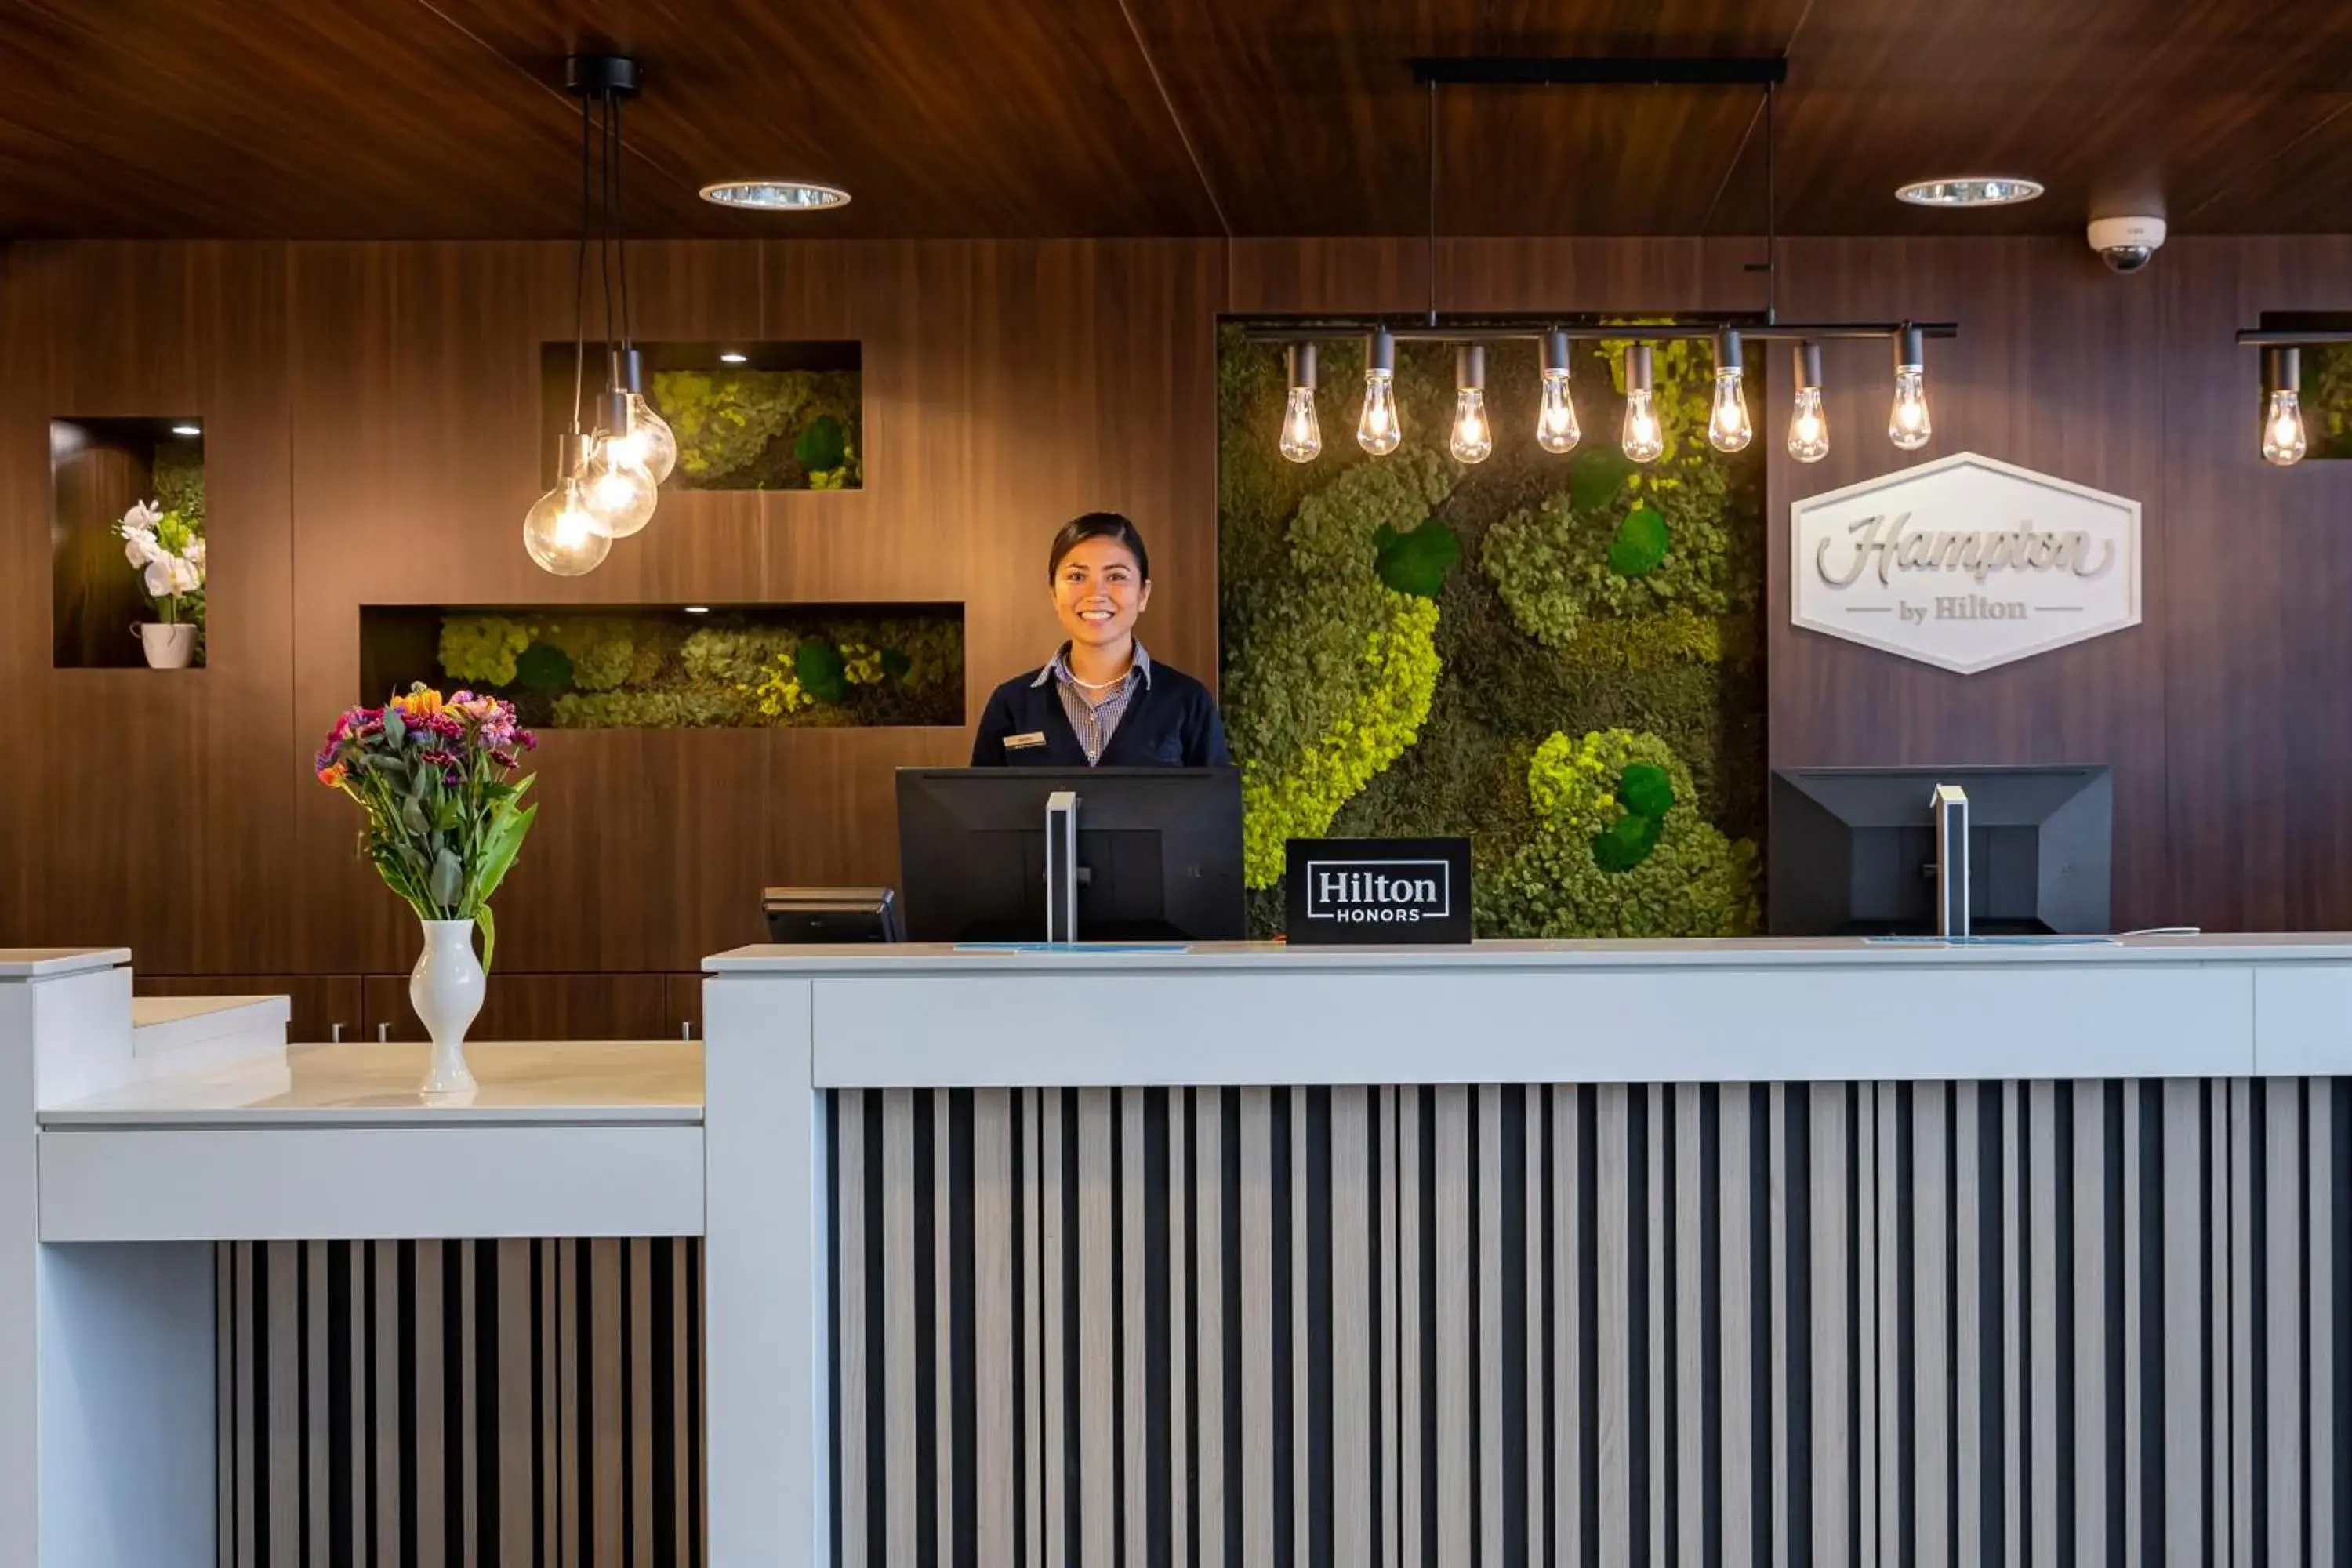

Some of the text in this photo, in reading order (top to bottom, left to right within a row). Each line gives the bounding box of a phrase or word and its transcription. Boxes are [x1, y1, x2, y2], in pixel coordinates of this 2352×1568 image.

[1816, 511, 2114, 589] Hampton
[1899, 594, 2028, 626] by Hilton
[1319, 872, 1437, 902] Hilton
[1337, 909, 1420, 922] HONORS
